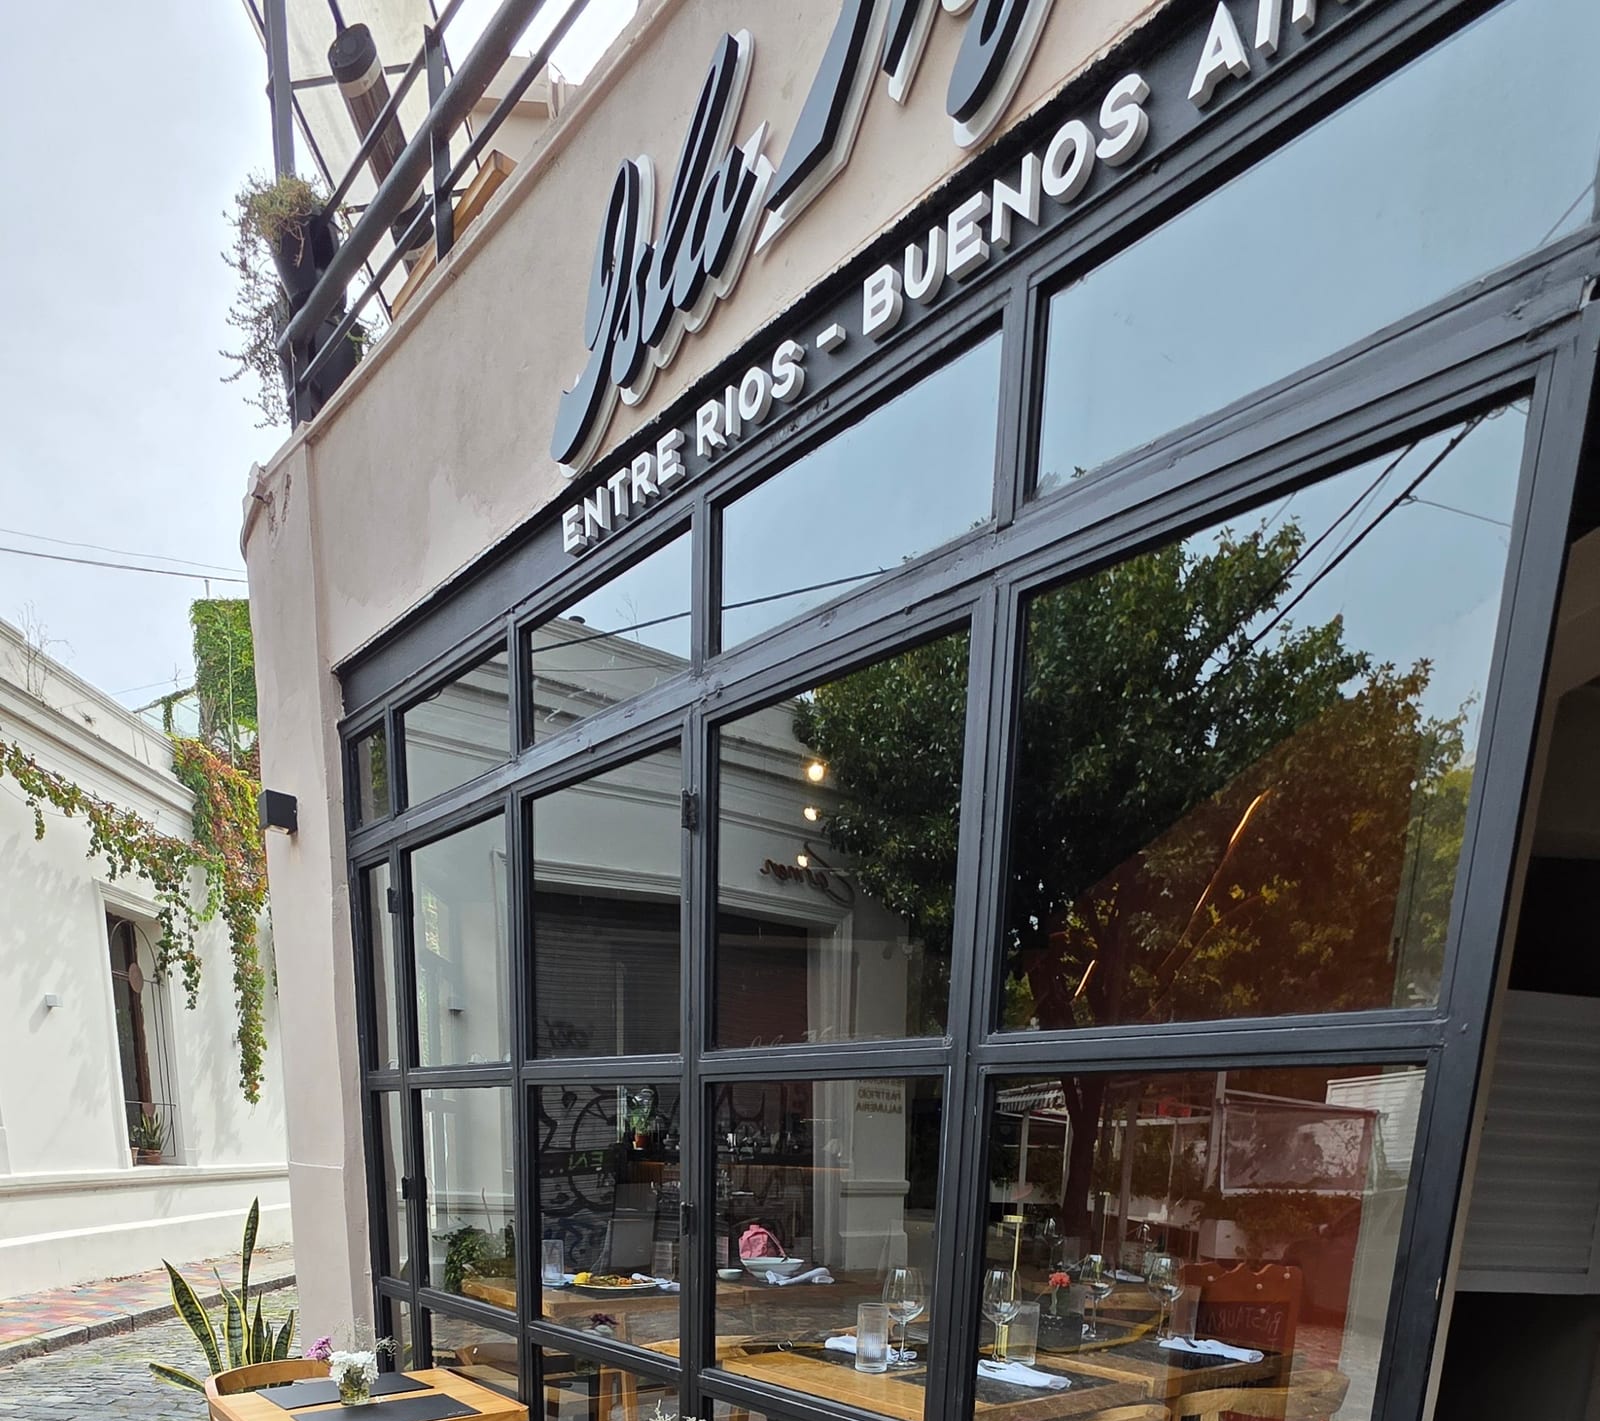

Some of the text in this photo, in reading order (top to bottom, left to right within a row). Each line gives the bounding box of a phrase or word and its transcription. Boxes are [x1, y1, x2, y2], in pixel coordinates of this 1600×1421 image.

[562, 428, 686, 555] ENTRE
[696, 339, 806, 458] RIOS
[863, 73, 1150, 342] BUENOS
